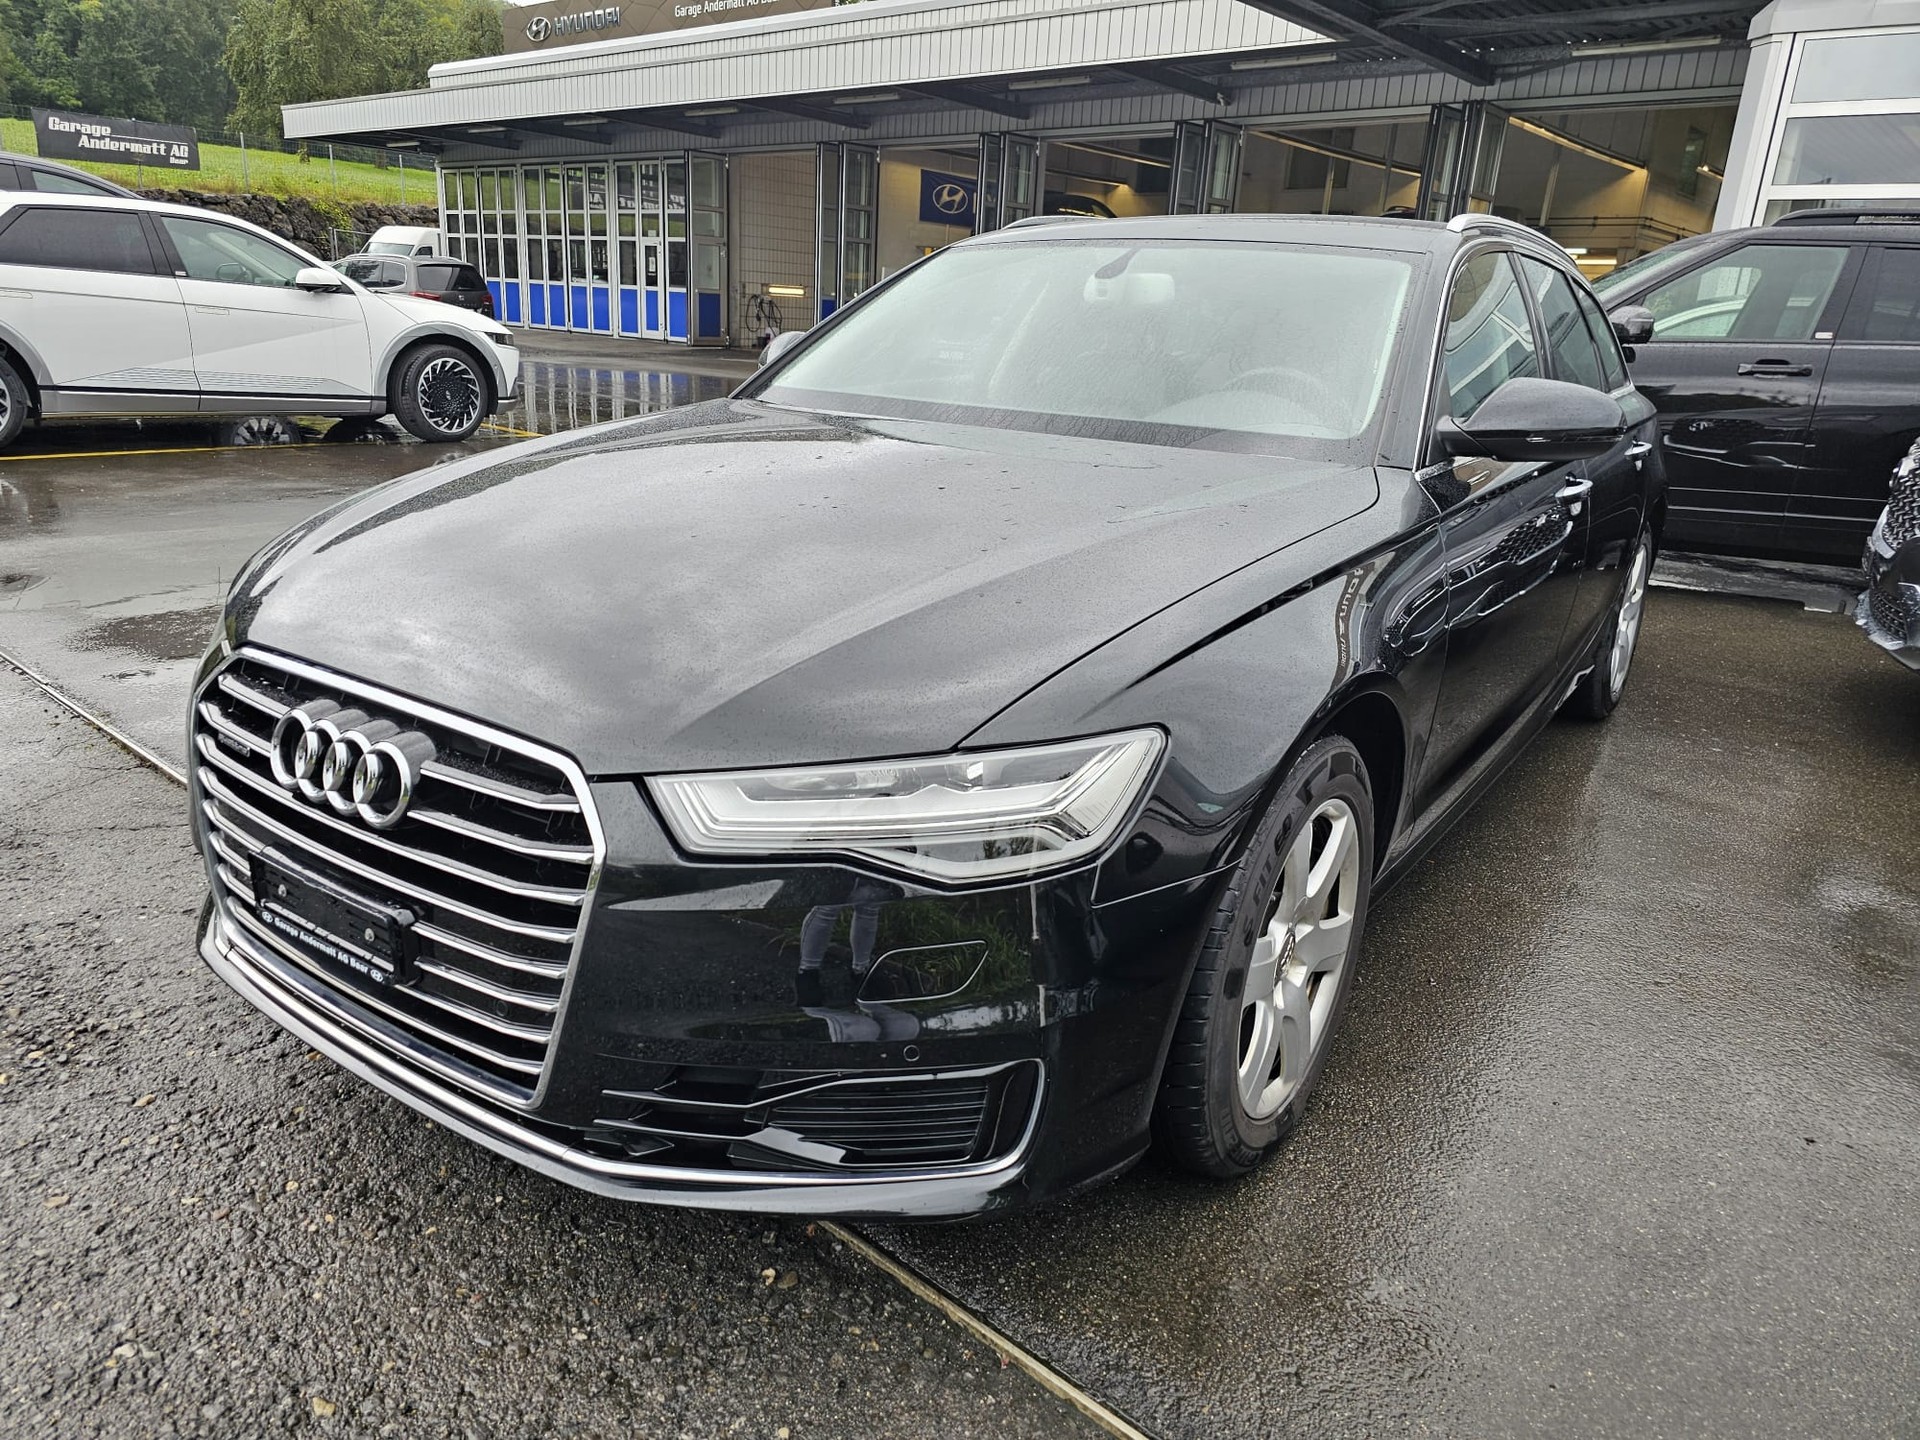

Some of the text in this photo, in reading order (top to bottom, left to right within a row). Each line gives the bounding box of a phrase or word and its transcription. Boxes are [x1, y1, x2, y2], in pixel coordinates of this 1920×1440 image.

[554, 6, 620, 36] HYUNDAI
[675, 4, 702, 17] Garage
[48, 116, 112, 137] Garage
[78, 134, 189, 158] Andermatt AG
[274, 917, 299, 938] Garage
[299, 931, 337, 957] Andermatt
